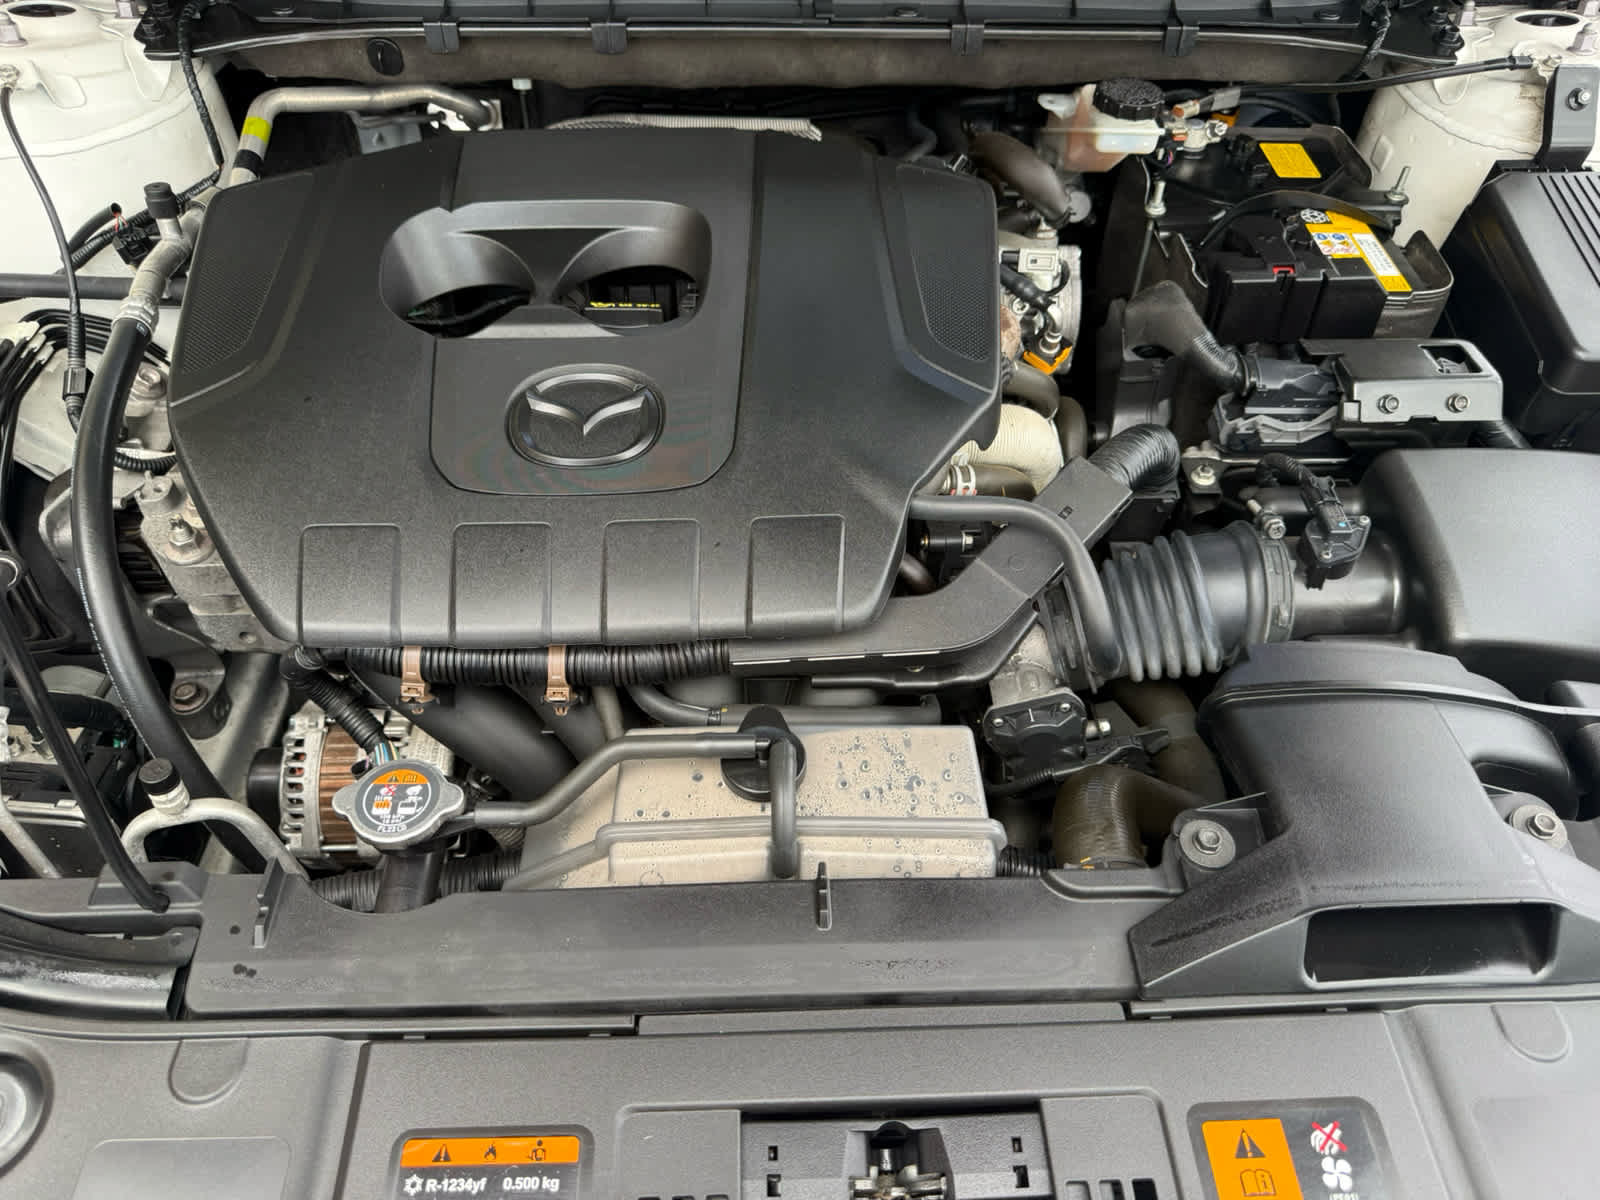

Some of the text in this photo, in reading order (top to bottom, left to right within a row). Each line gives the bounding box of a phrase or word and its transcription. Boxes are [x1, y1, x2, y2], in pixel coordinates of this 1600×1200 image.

[425, 1176, 560, 1194] R-1234yf 0.500 kg
